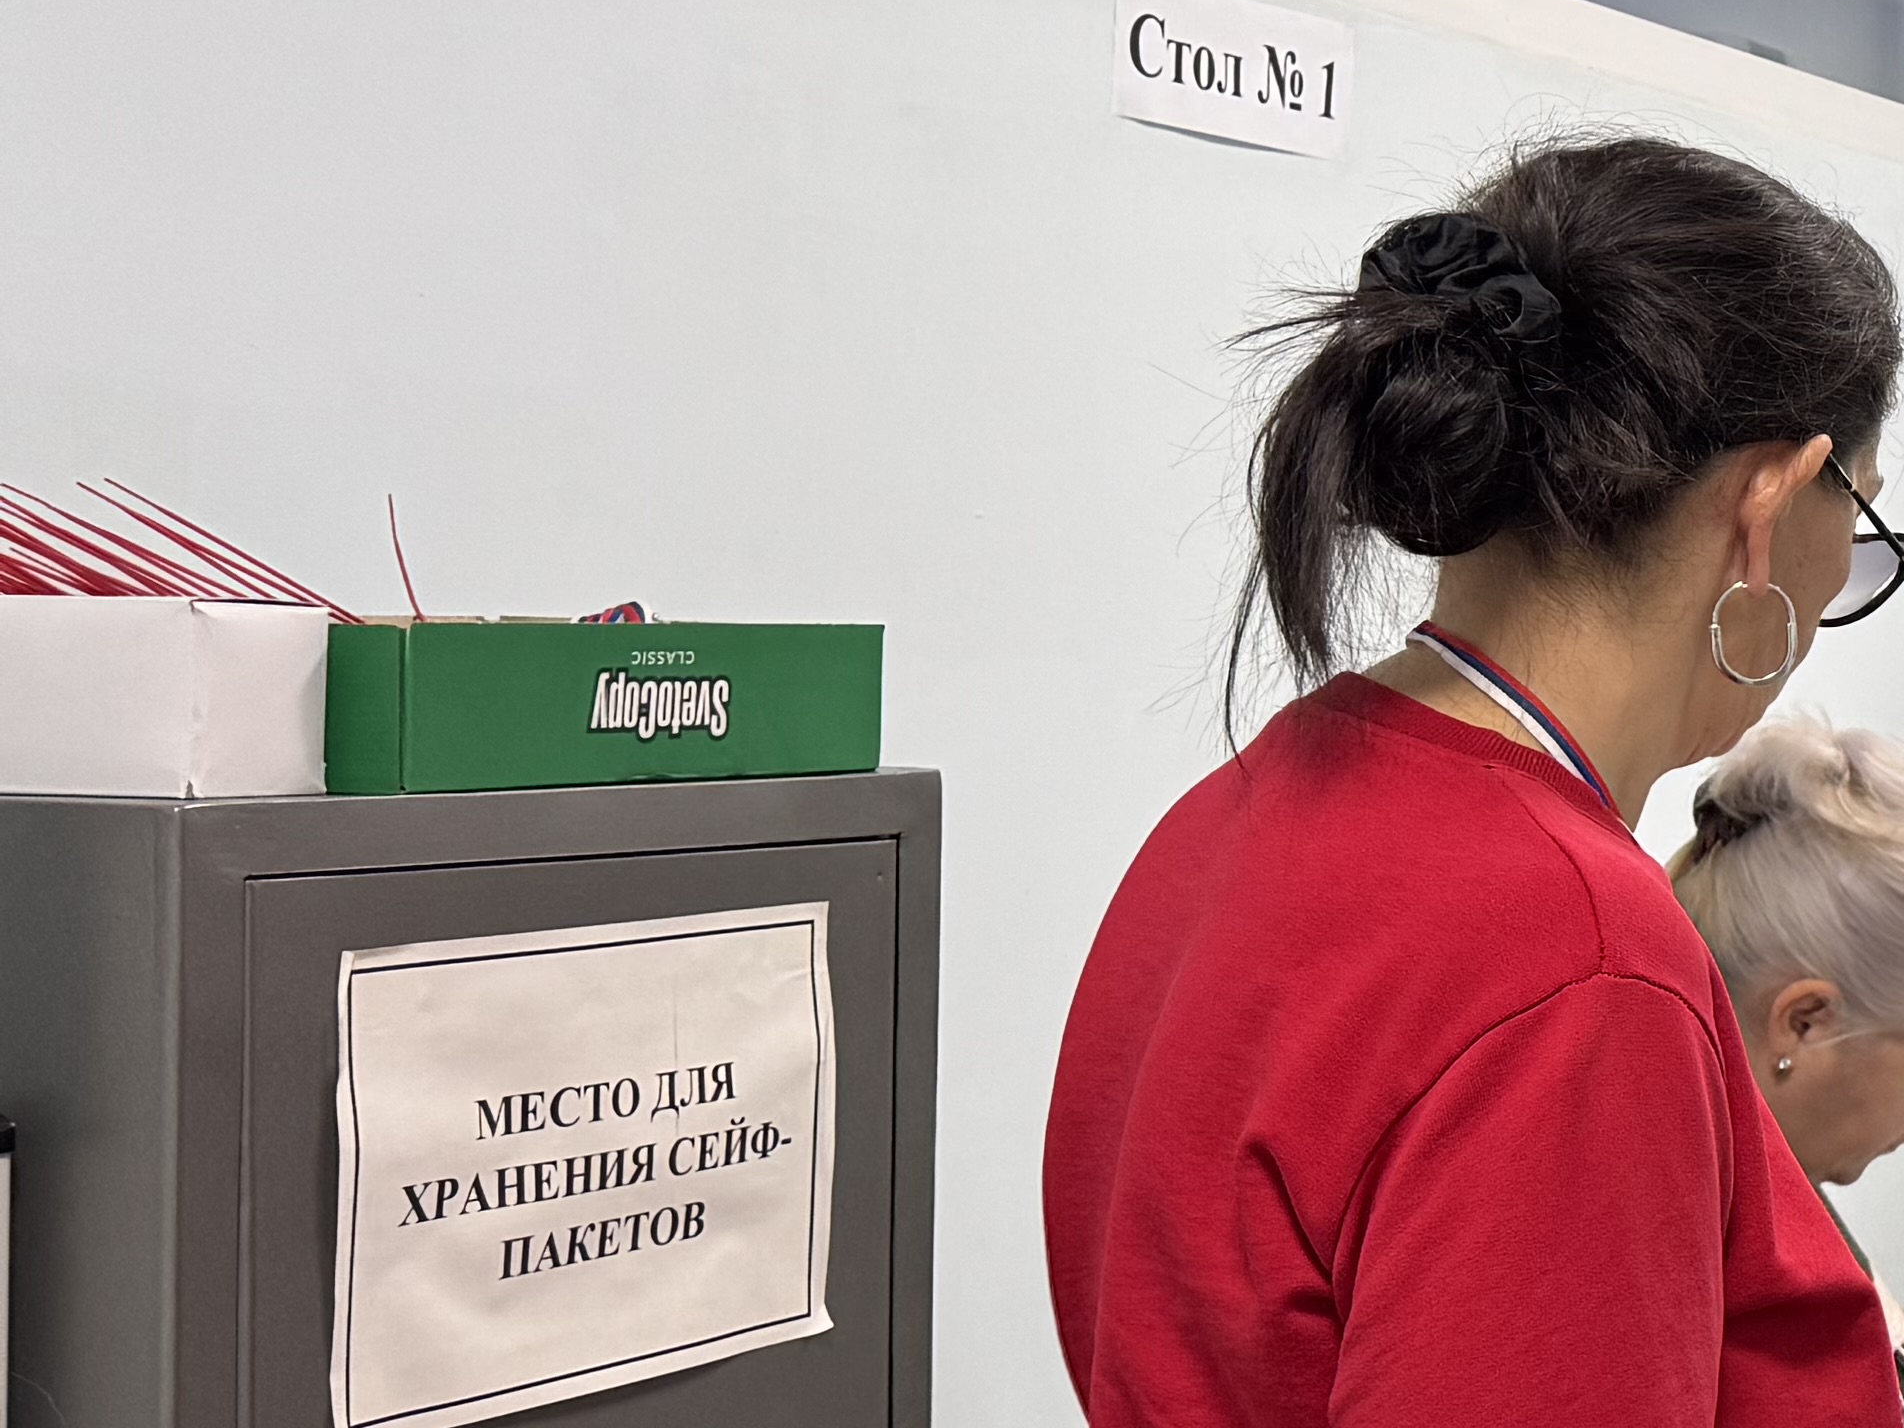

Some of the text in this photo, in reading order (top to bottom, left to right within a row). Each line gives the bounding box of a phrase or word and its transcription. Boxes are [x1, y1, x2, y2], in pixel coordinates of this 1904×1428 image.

[1129, 13, 1335, 120] Стол № 1
[631, 651, 695, 665] CLASSIC
[590, 672, 730, 739] SvetoCopy
[474, 1061, 736, 1140] МЕСТО ДЛЯ
[397, 1116, 792, 1228] ХРАНЕНИЯ СЕЙФ-
[498, 1201, 705, 1281] ПАКЕТОВ
